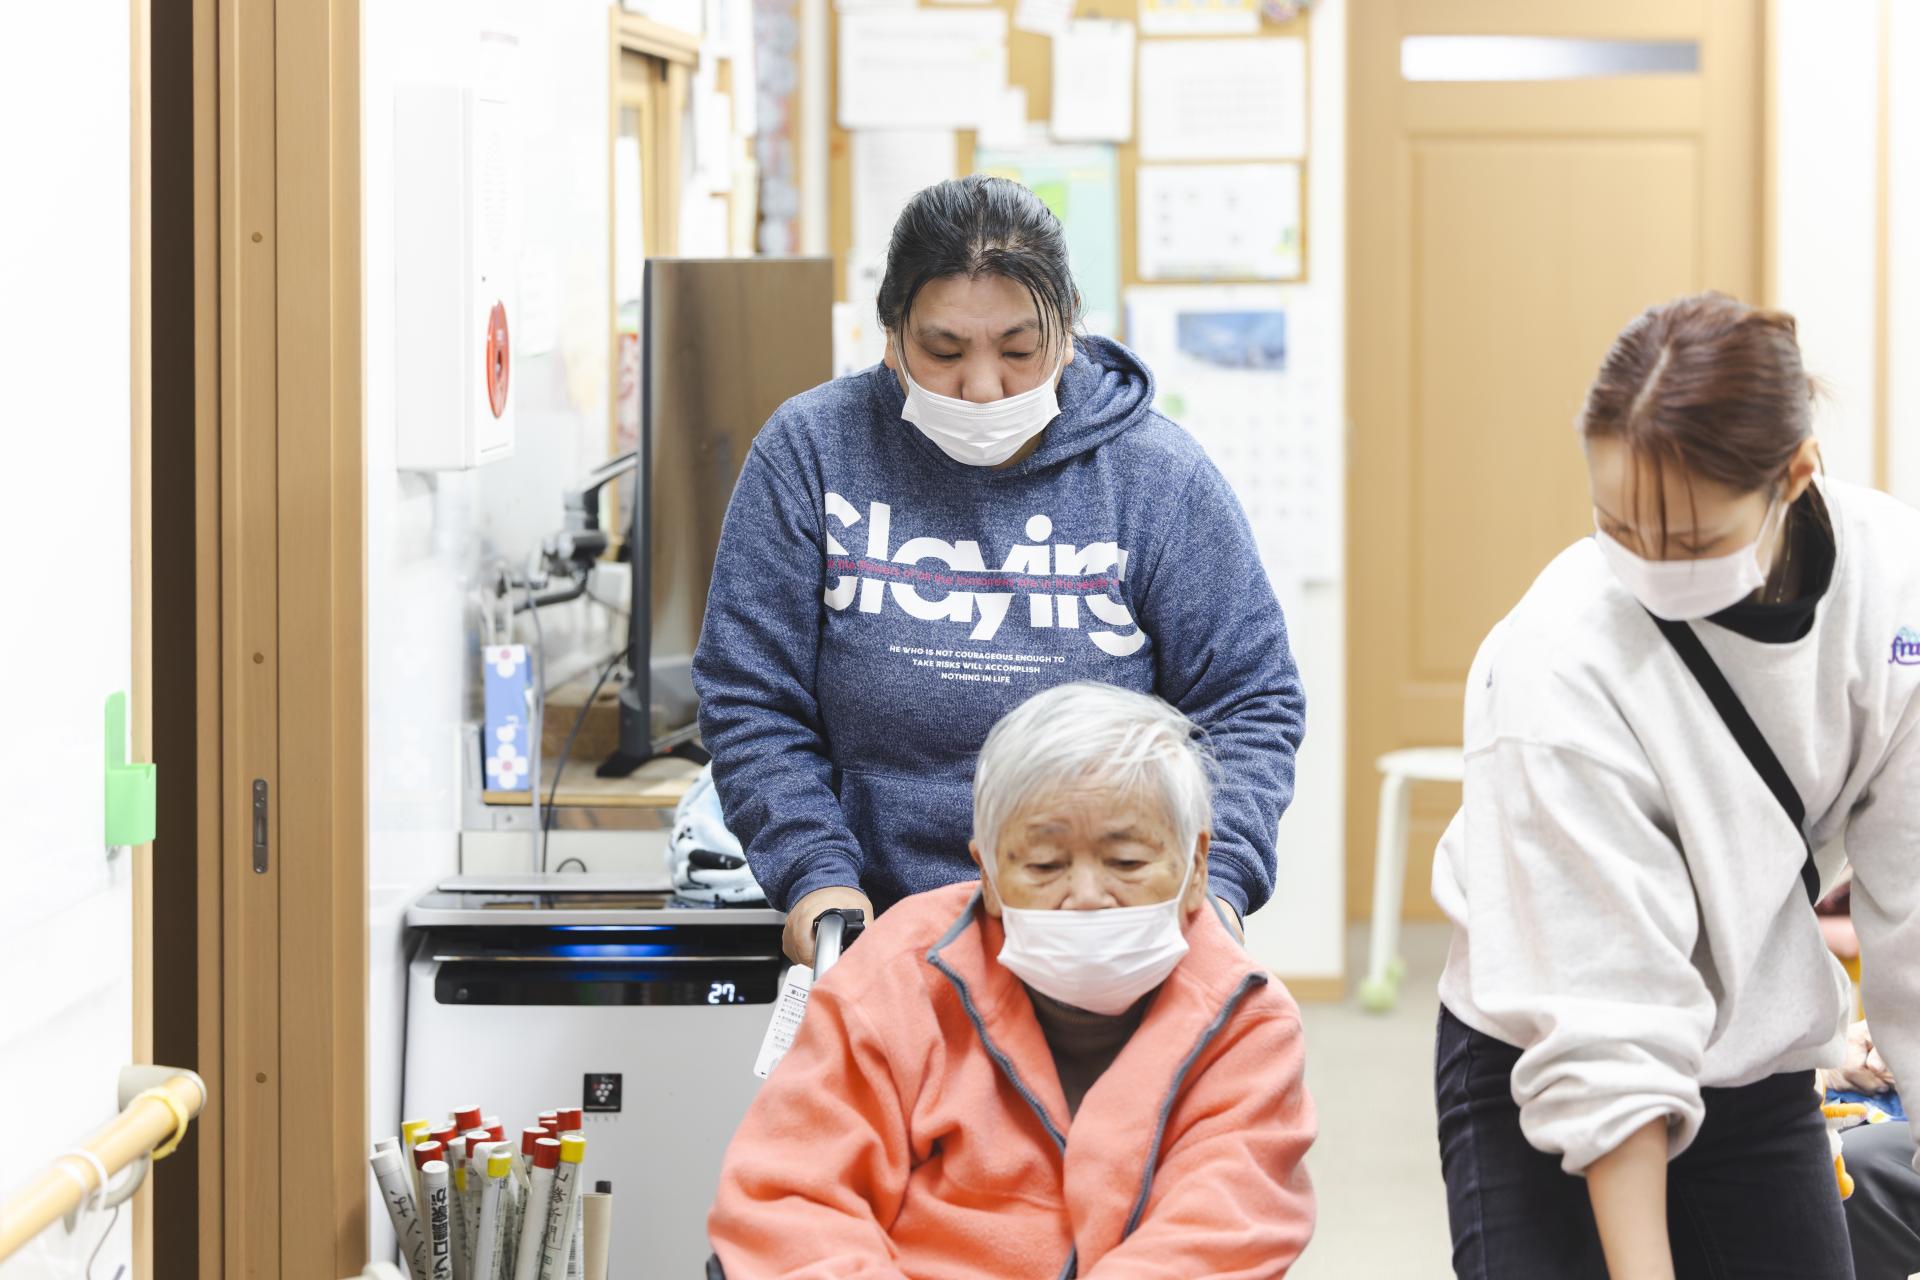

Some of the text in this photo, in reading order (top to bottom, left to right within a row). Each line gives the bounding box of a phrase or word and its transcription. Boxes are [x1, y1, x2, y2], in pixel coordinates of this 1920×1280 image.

[889, 645, 901, 653] HE
[902, 646, 924, 655] WHO
[925, 648, 934, 656] IS
[935, 649, 954, 658] NOT
[955, 651, 1014, 661] COURAGEOUS
[1015, 654, 1052, 663] ENOUGH
[912, 658, 1041, 674] TAKE RISKS WILL ACCOMPLISH
[941, 672, 1011, 683] NOTHING IN LIFE
[707, 983, 736, 1004] 27
